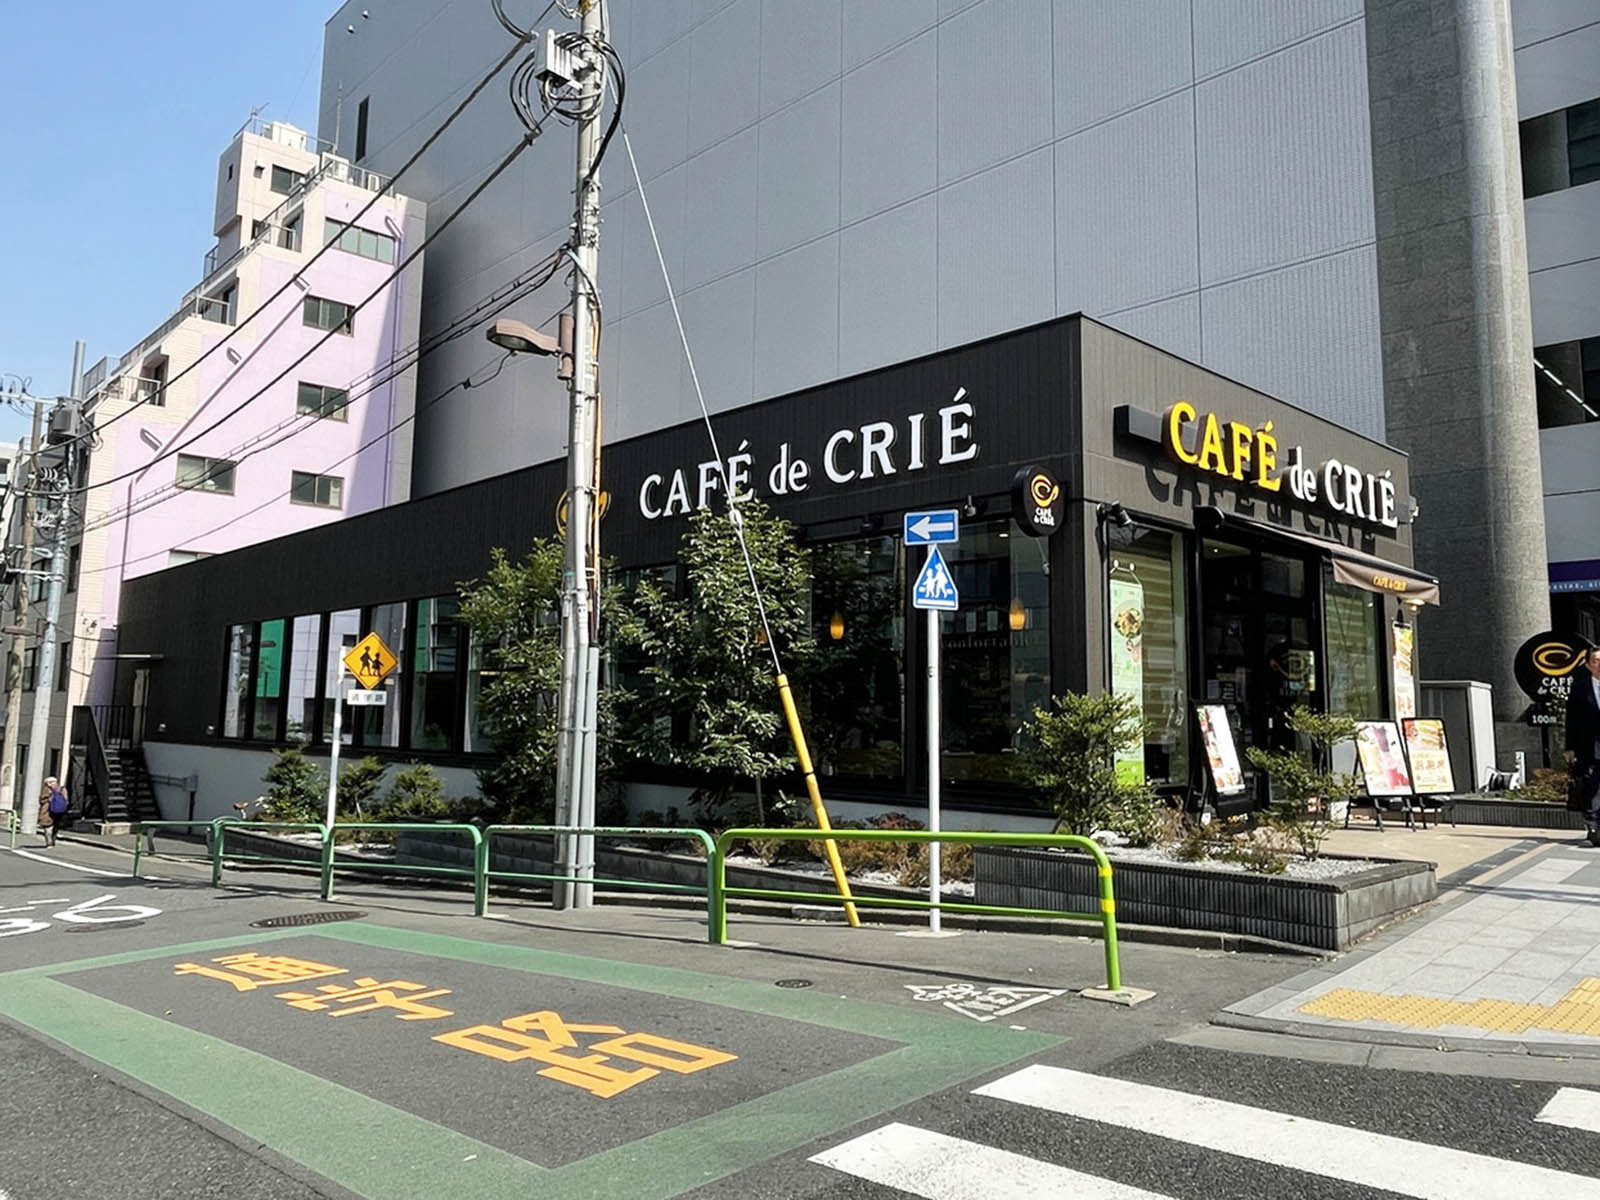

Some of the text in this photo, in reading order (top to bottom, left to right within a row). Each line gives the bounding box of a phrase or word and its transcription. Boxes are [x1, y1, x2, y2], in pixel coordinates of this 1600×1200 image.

[639, 386, 978, 519] CAFÉ de CRIÉ
[1169, 401, 1398, 529] CAFÉ de CRIÉ
[1550, 686, 1571, 695] CRI
[173, 952, 739, 1099] 通学路
